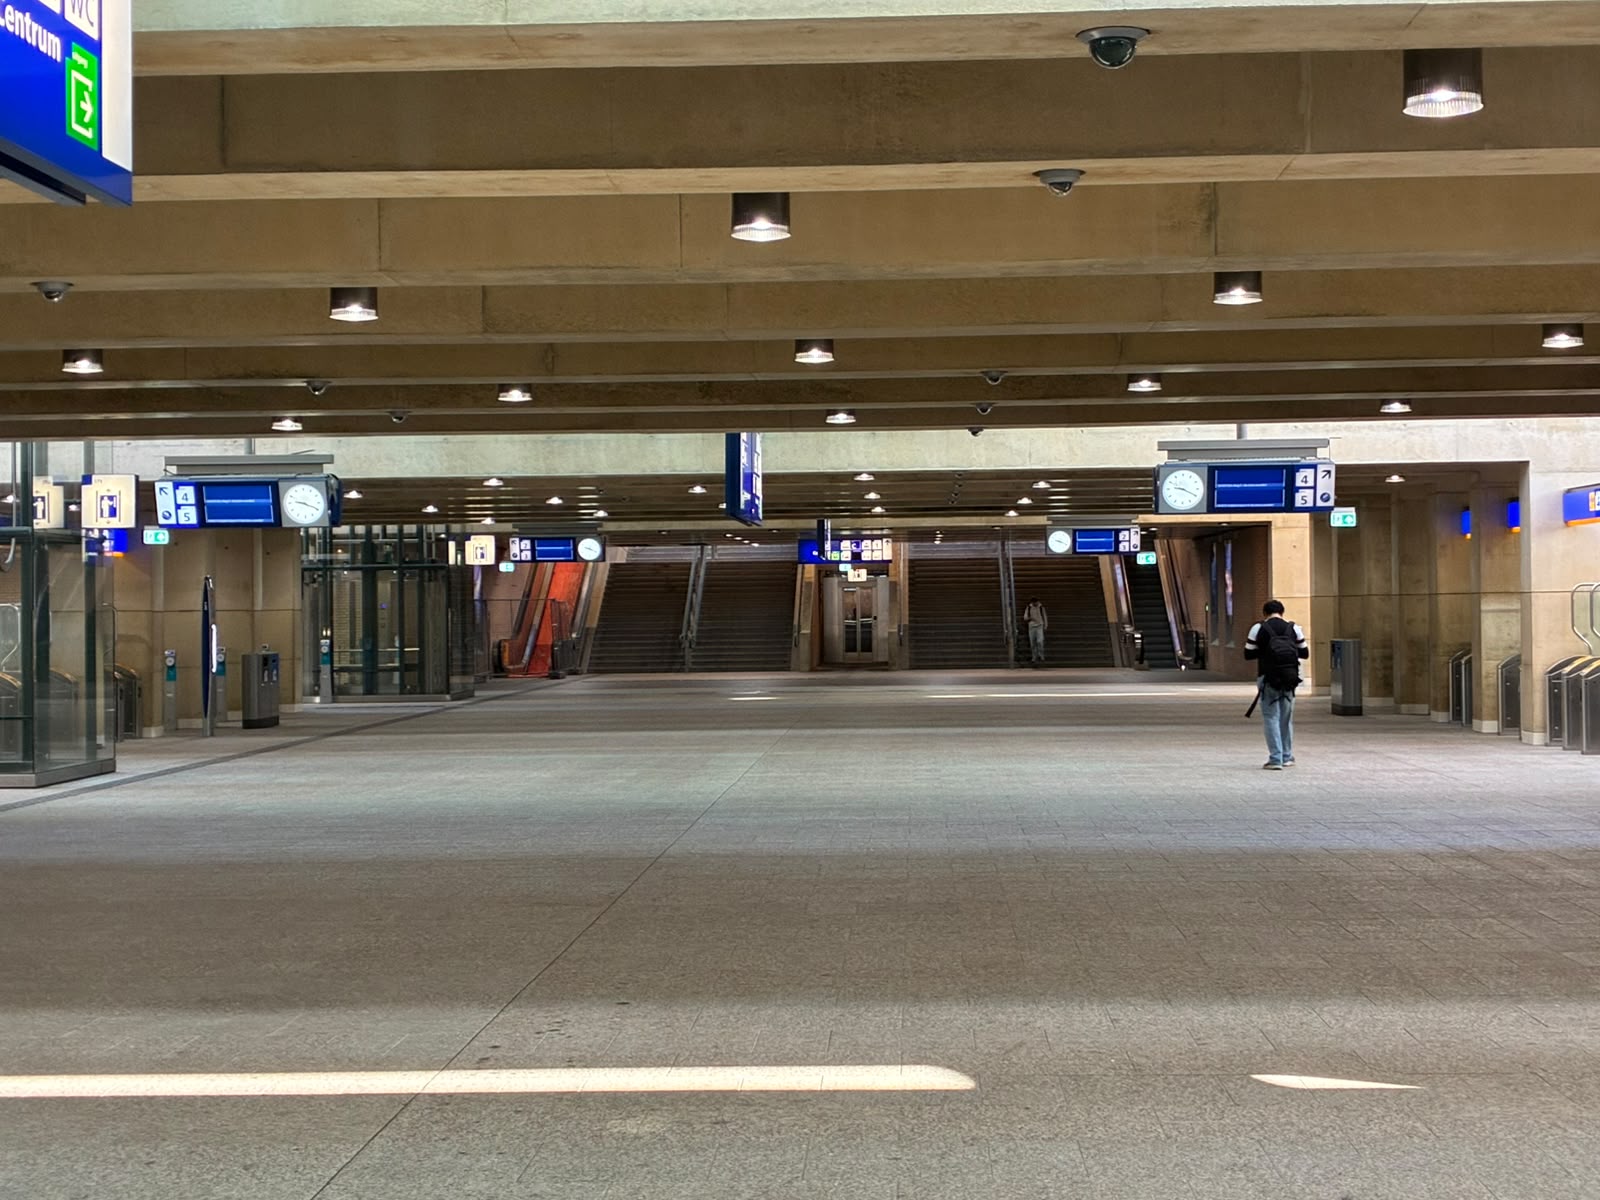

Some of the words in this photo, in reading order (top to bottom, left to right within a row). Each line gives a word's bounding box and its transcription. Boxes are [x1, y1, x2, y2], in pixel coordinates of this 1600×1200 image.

[1300, 475, 1308, 485] 4
[181, 492, 189, 502] 4
[1301, 495, 1308, 505] 5
[183, 512, 191, 522] 5
